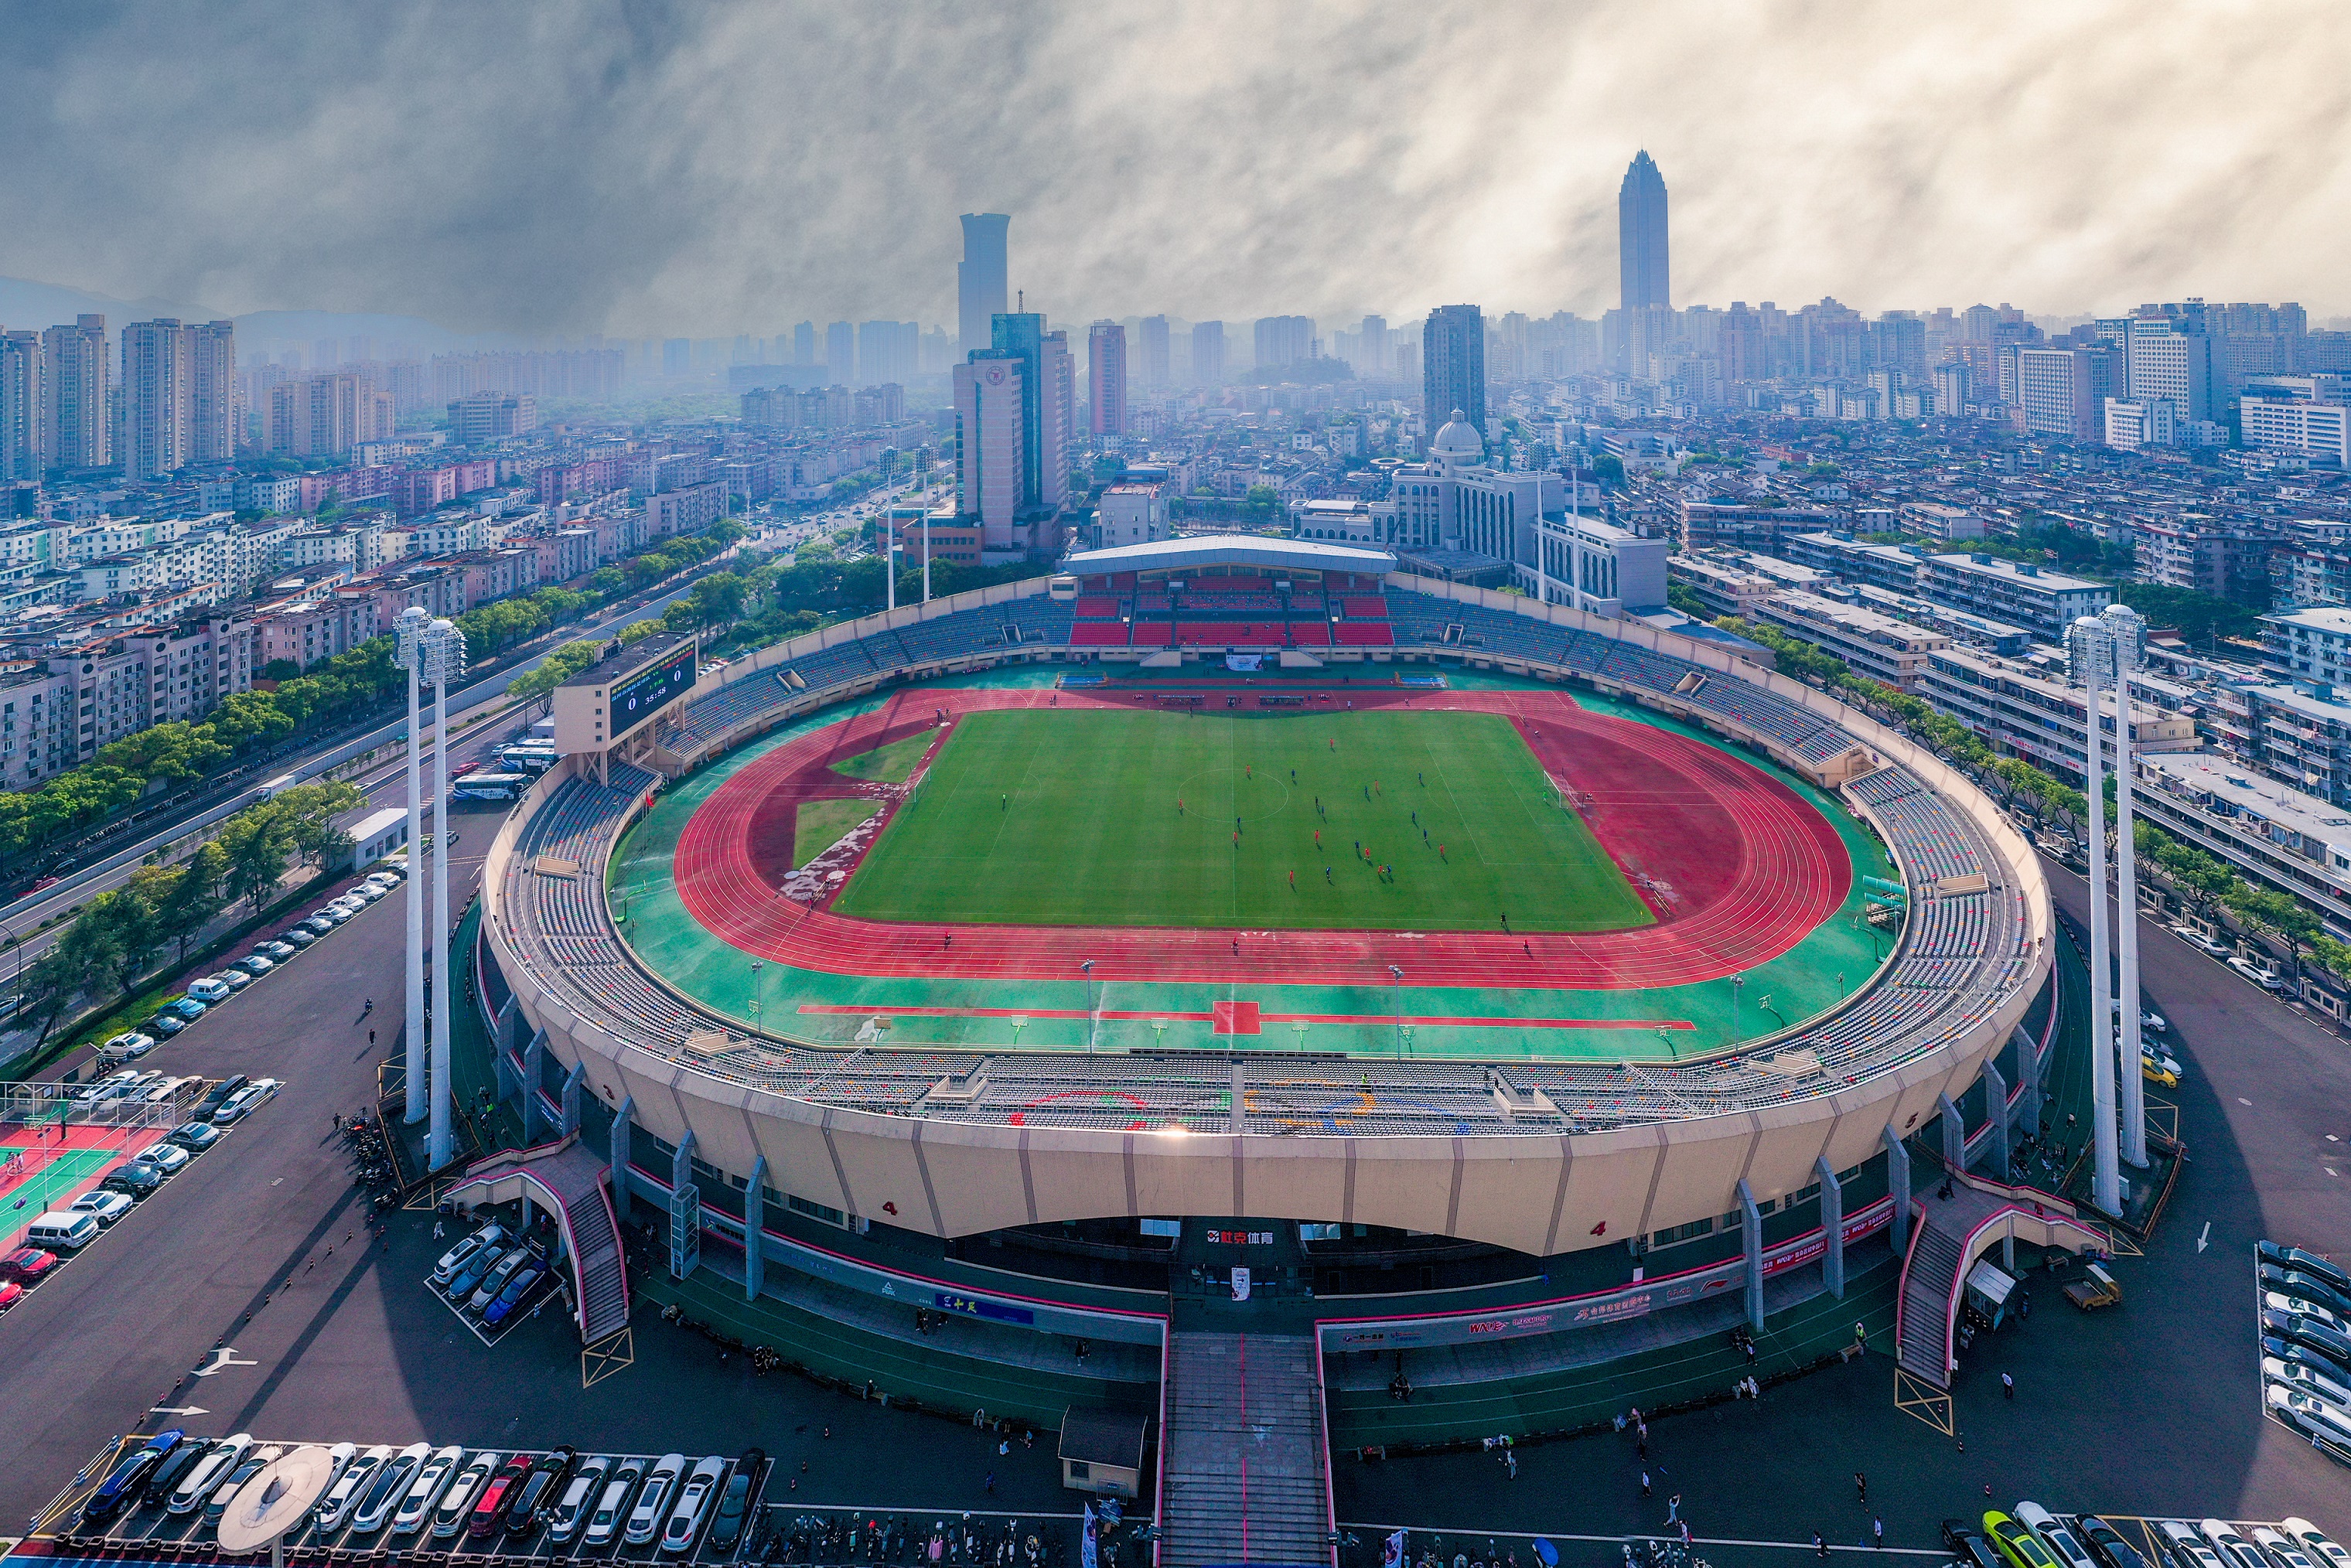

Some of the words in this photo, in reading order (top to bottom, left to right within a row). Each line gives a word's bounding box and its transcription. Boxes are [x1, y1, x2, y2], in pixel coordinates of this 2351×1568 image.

[628, 697, 636, 711] 0
[674, 670, 681, 682] 0
[645, 687, 666, 705] 35:58
[882, 1200, 898, 1216] 4
[1590, 1221, 1606, 1236] 4
[1221, 1231, 1273, 1244] 杜克体育
[882, 1287, 896, 1297] PEAK
[954, 1297, 977, 1314] 十足
